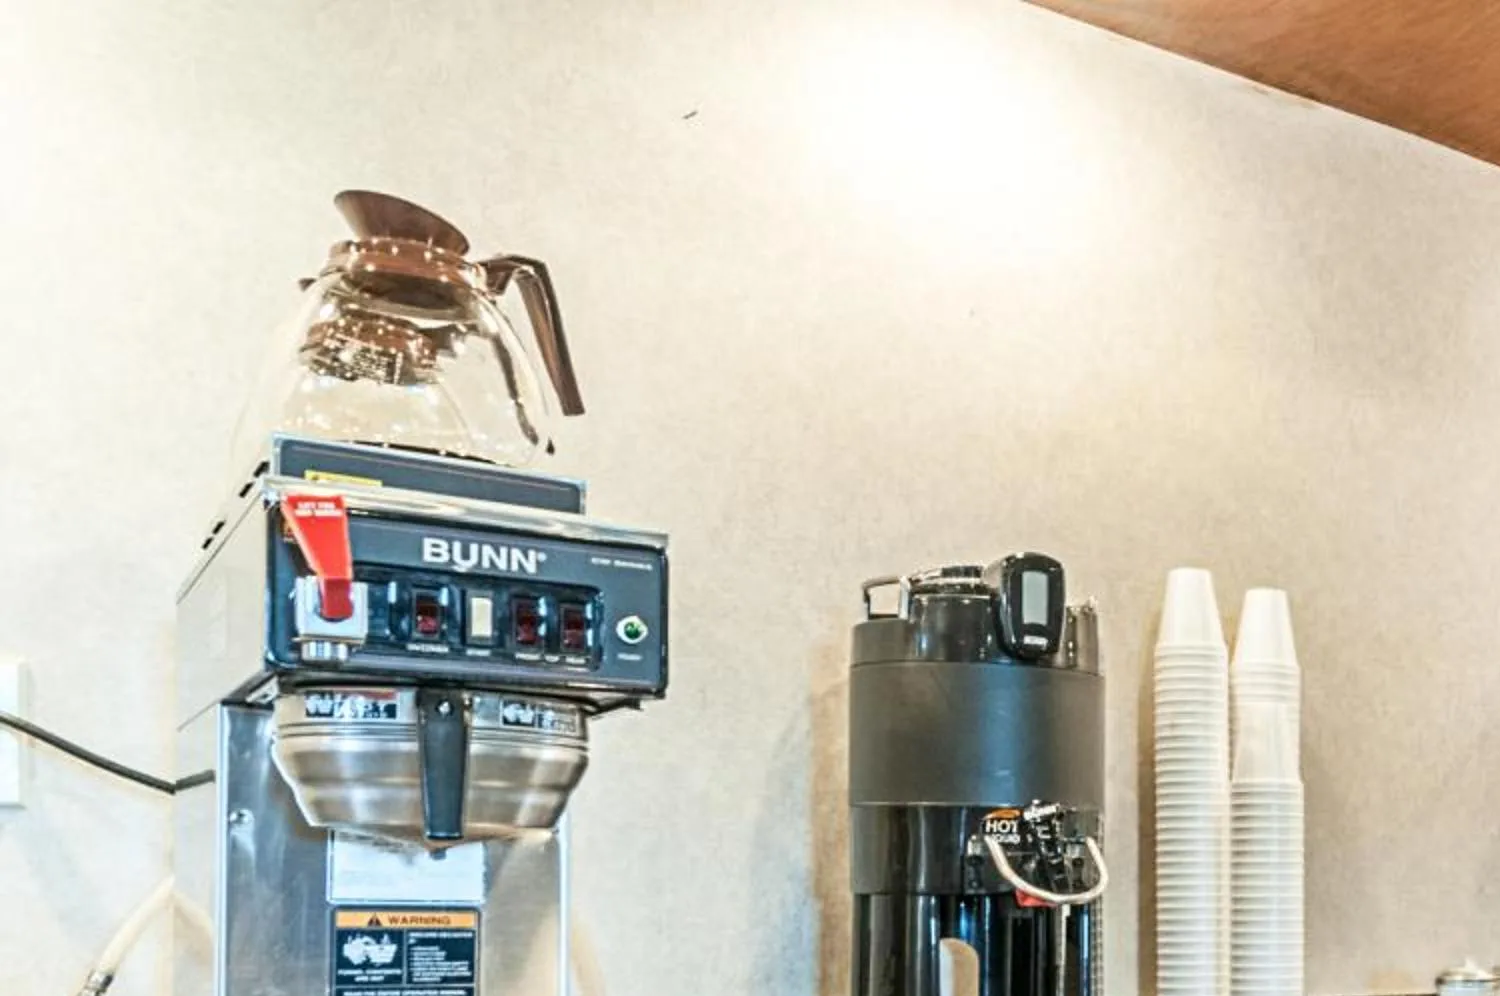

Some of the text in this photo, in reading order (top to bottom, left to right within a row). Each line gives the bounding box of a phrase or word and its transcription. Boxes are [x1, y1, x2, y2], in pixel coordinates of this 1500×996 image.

[423, 538, 537, 573] BUNN
[985, 819, 1018, 833] HOT
[388, 915, 451, 926] WARNING
